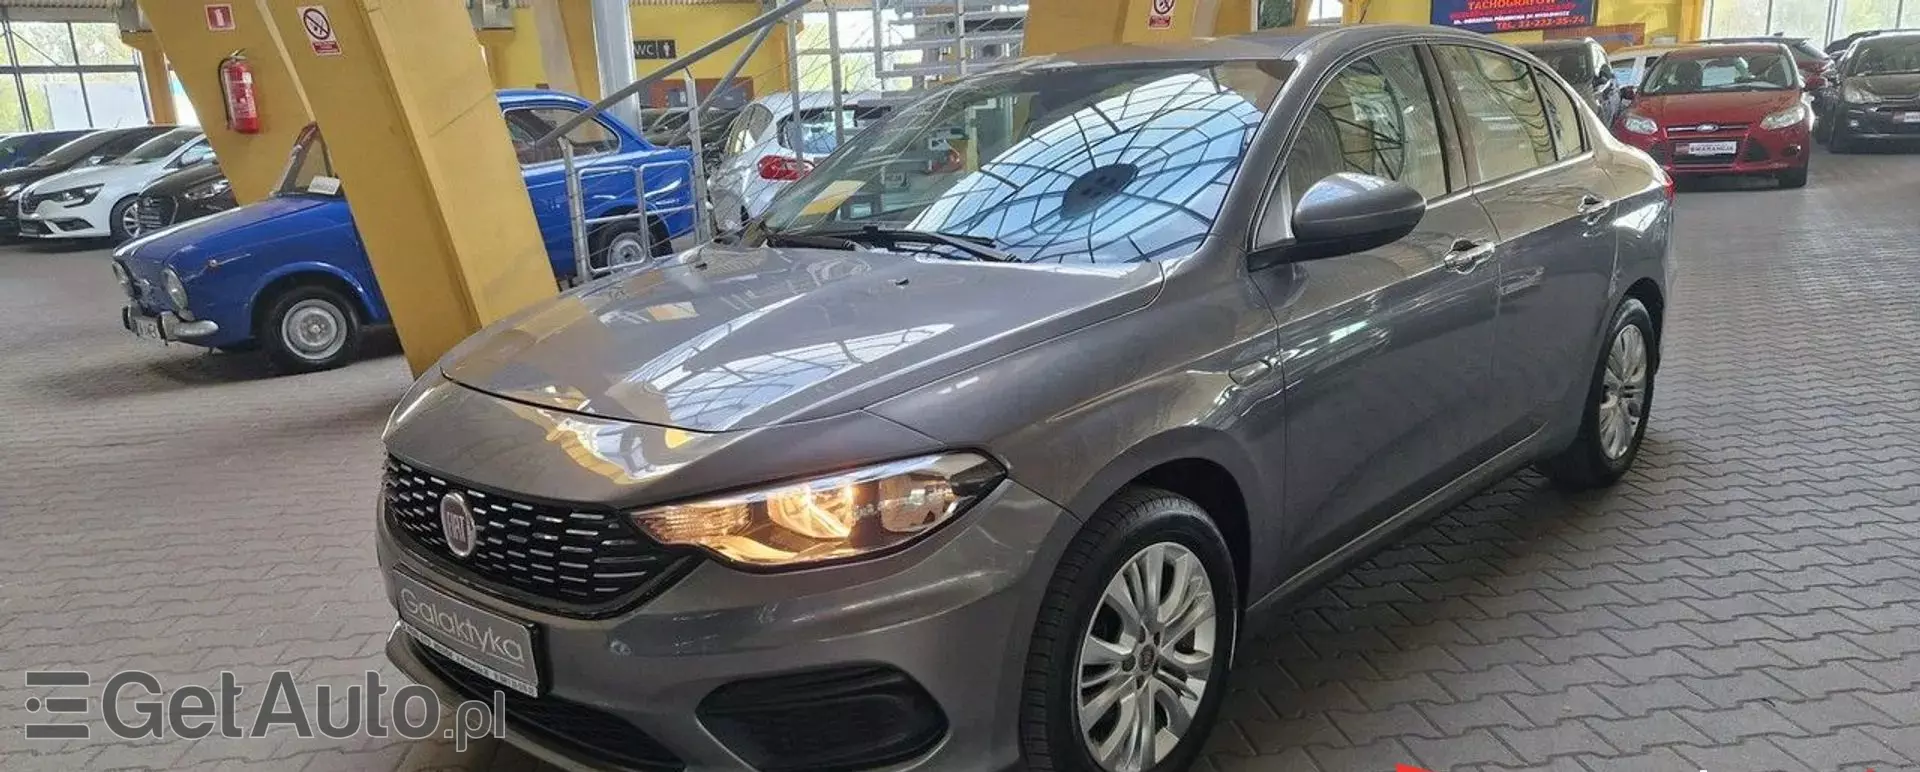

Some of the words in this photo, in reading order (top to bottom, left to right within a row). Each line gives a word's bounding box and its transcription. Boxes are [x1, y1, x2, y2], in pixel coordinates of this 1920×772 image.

[634, 44, 654, 55] WC
[446, 511, 466, 542] FIAT
[401, 588, 525, 663] Galaktyka
